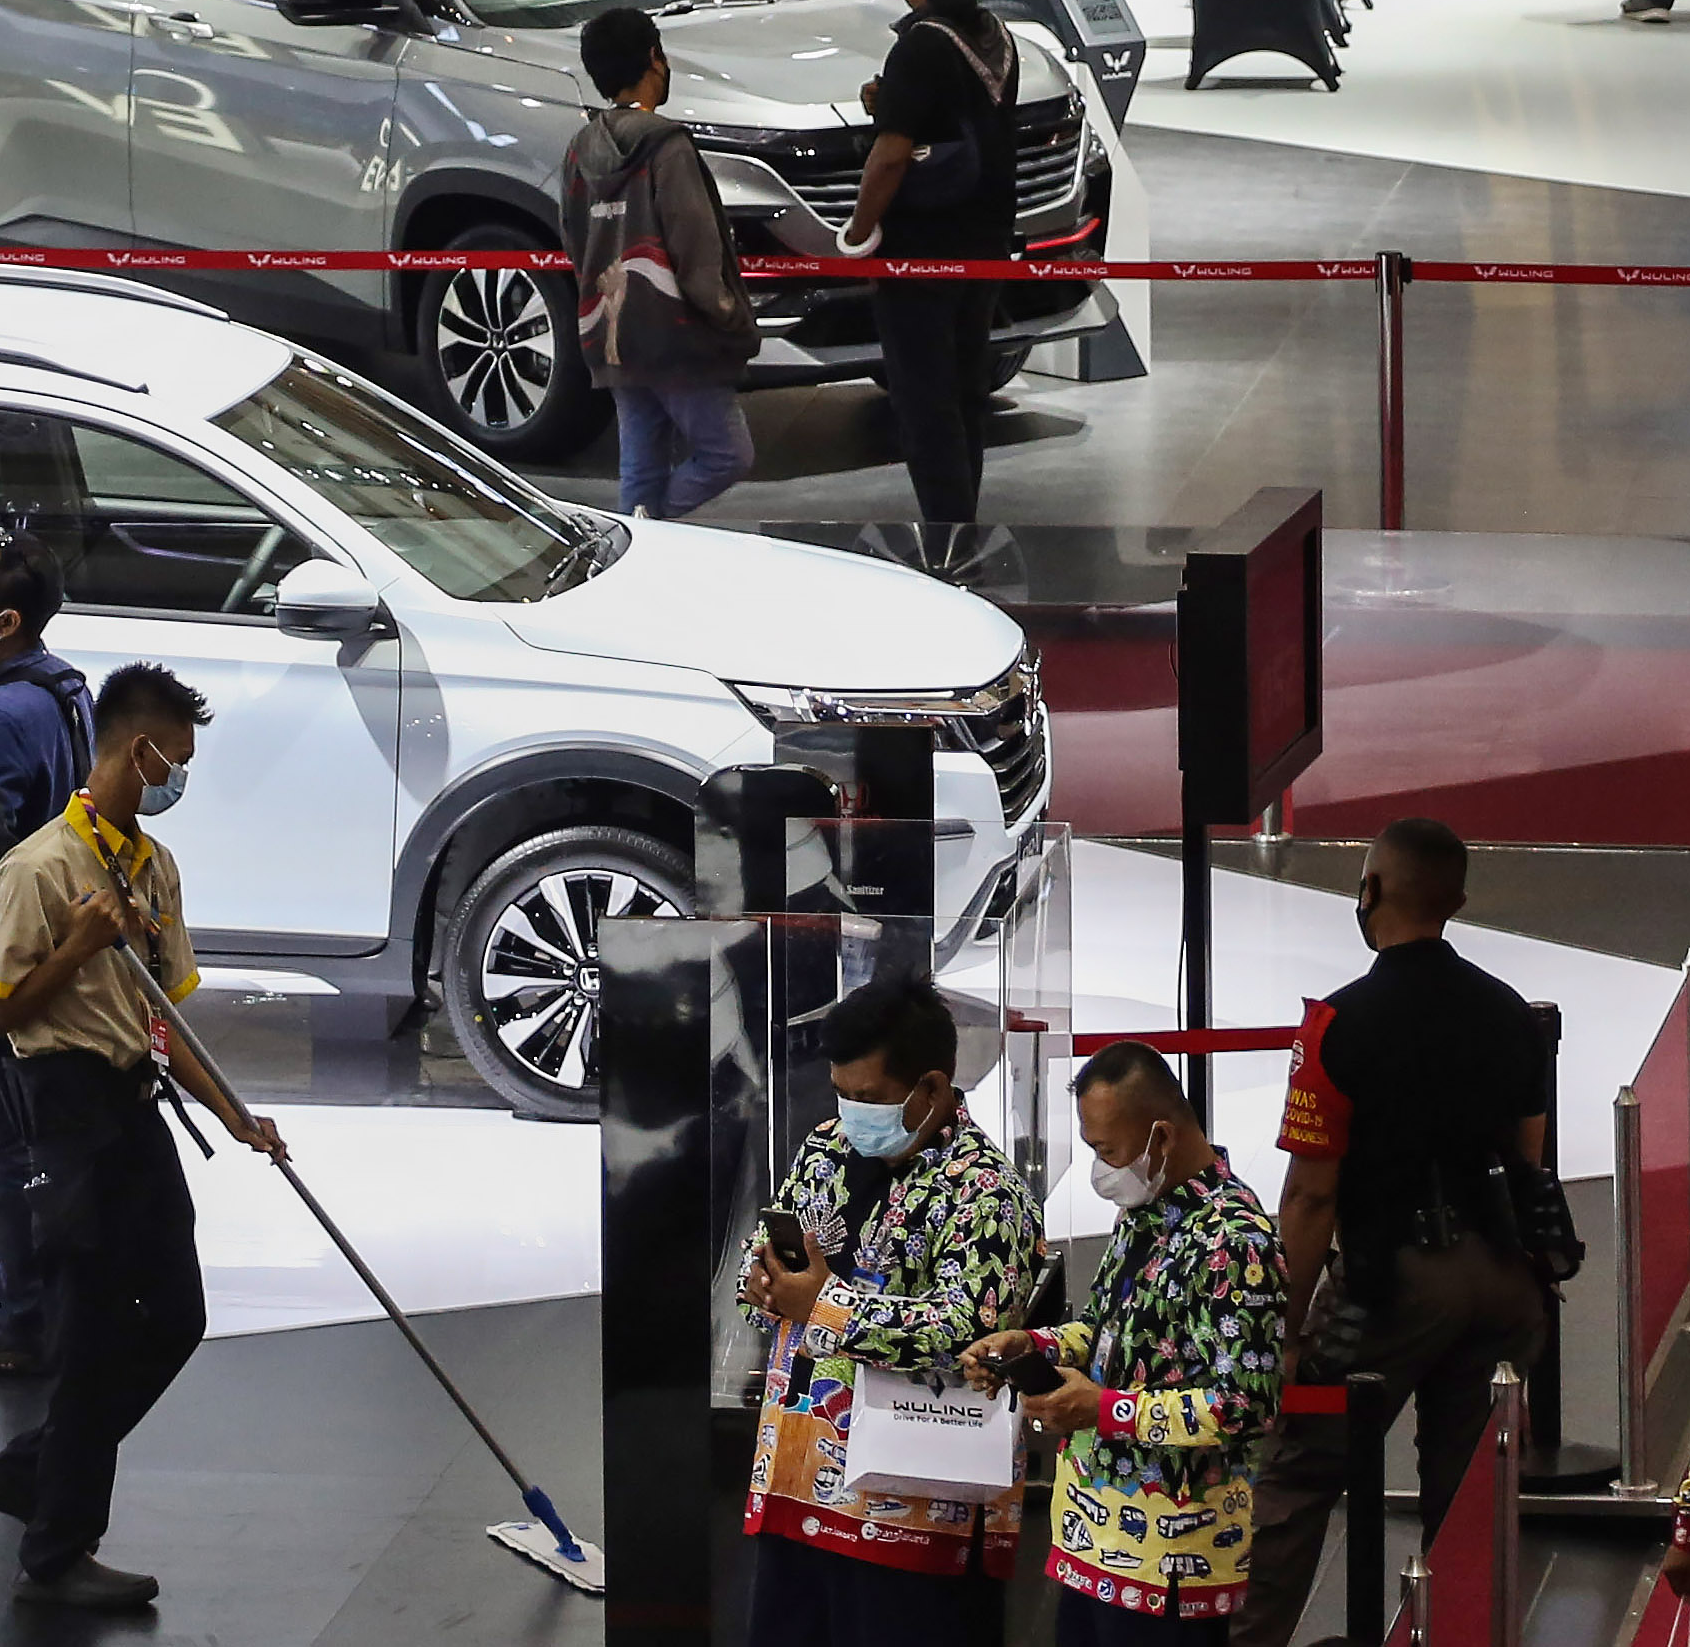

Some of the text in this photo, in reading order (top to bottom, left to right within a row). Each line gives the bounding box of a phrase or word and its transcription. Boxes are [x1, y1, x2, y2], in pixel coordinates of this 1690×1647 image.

[131, 254, 186, 265] WULING
[271, 255, 327, 265] WULING
[411, 255, 467, 265] WULING
[910, 263, 966, 273] WULING
[1053, 265, 1109, 276] WULING
[1196, 265, 1252, 276] WULING
[1498, 268, 1554, 278] WULING
[893, 1400, 983, 1418] WULING
[893, 1413, 916, 1421] Drive
[917, 1415, 931, 1423] For
[940, 1417, 966, 1427] Better
[968, 1420, 983, 1429] Life
